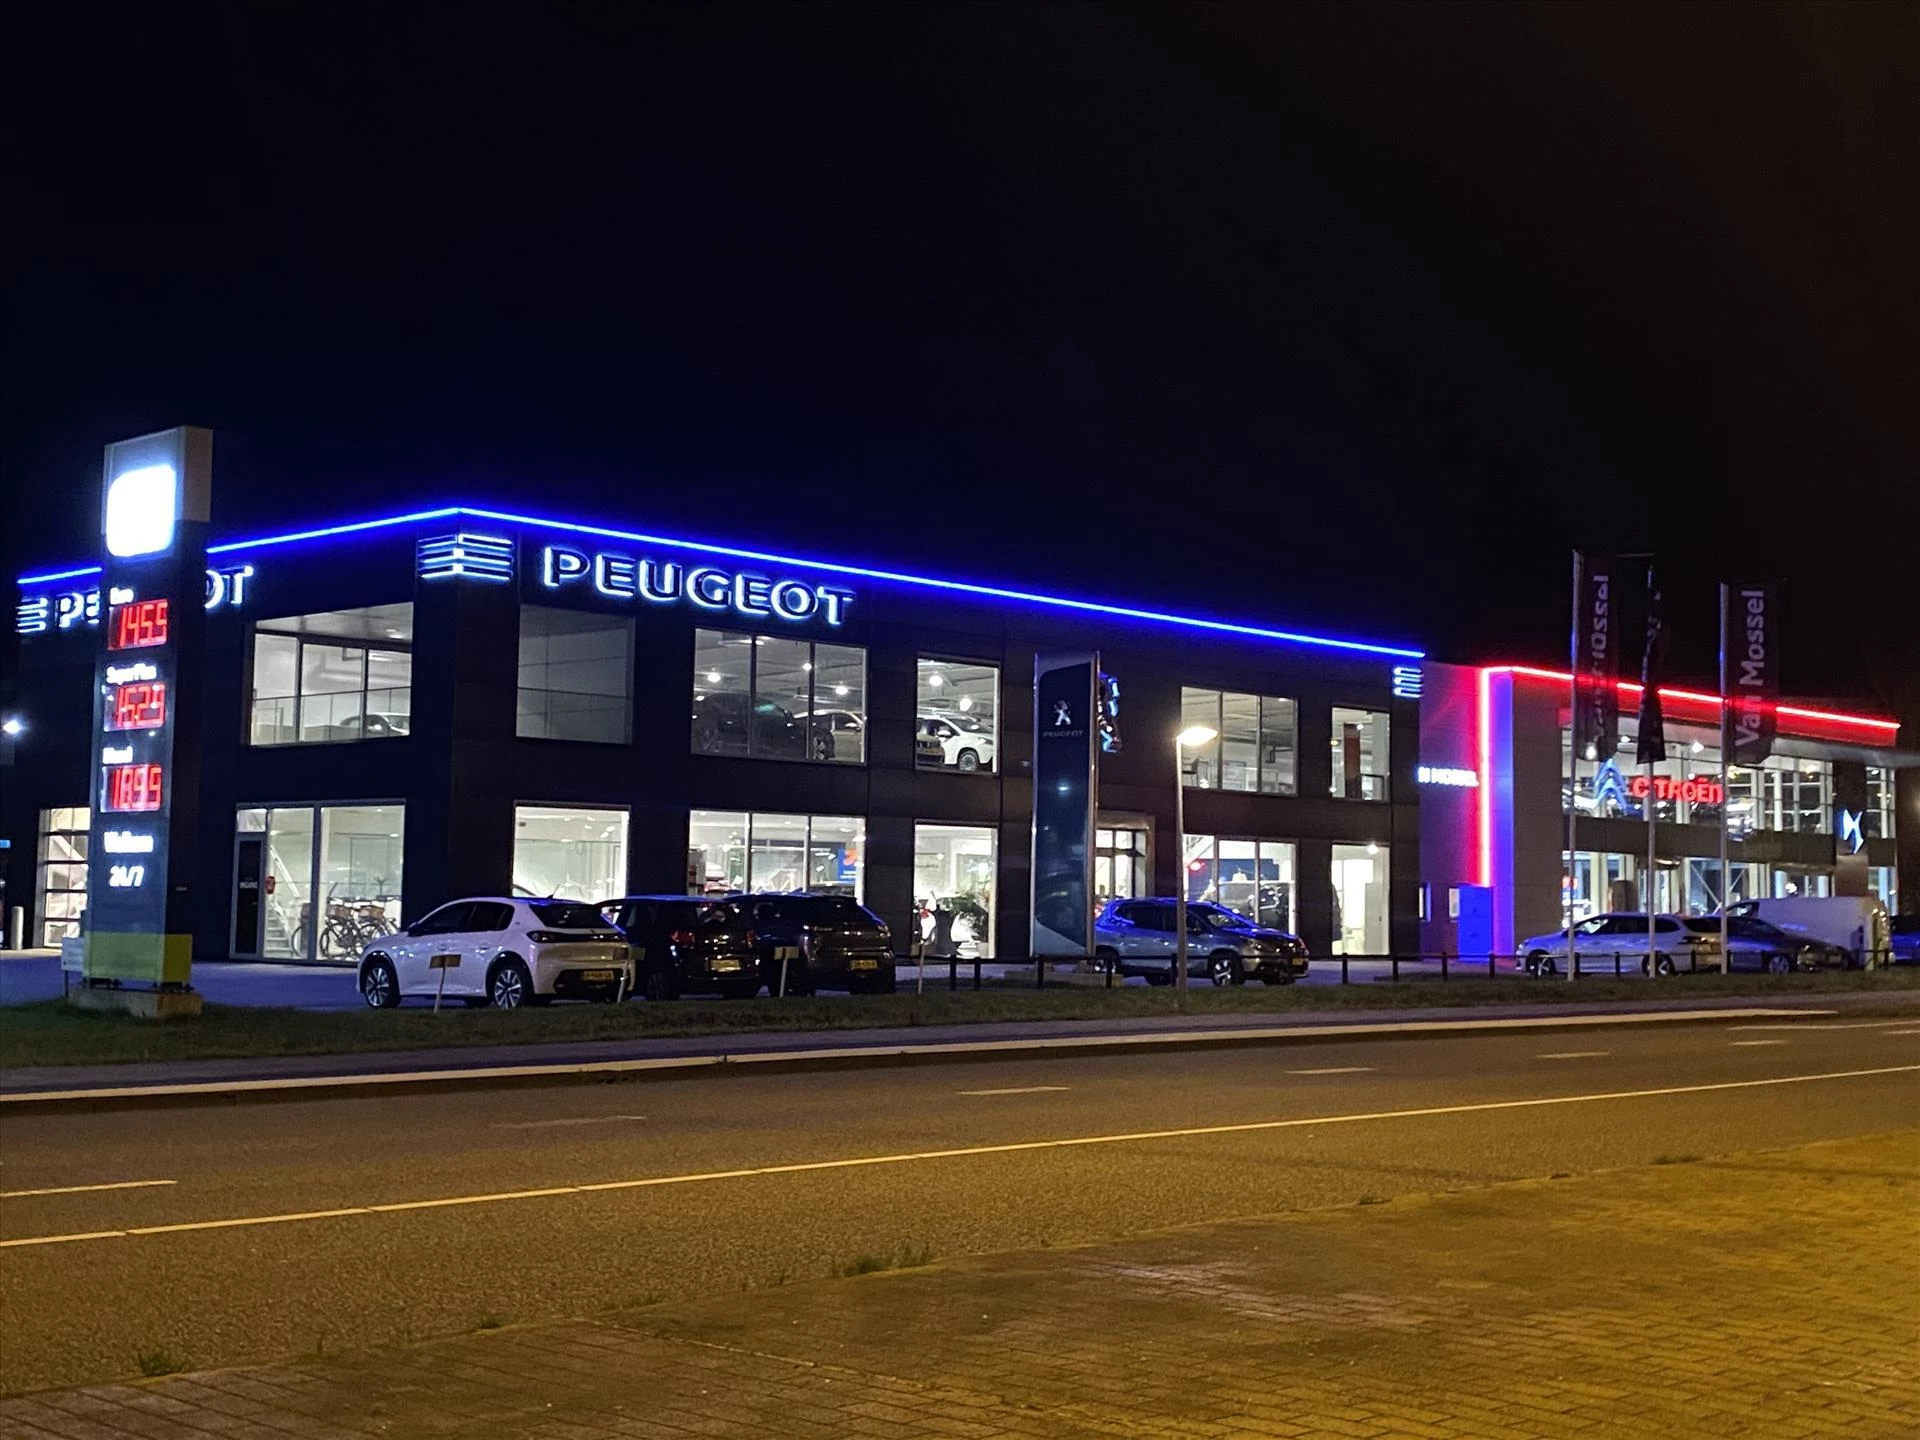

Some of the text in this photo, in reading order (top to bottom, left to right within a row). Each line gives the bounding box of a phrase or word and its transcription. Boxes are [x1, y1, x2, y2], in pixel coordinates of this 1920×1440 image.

[544, 547, 855, 625] PEUGEOT
[1735, 590, 1764, 746] Van Mossel
[1632, 777, 1724, 804] CTROËN
